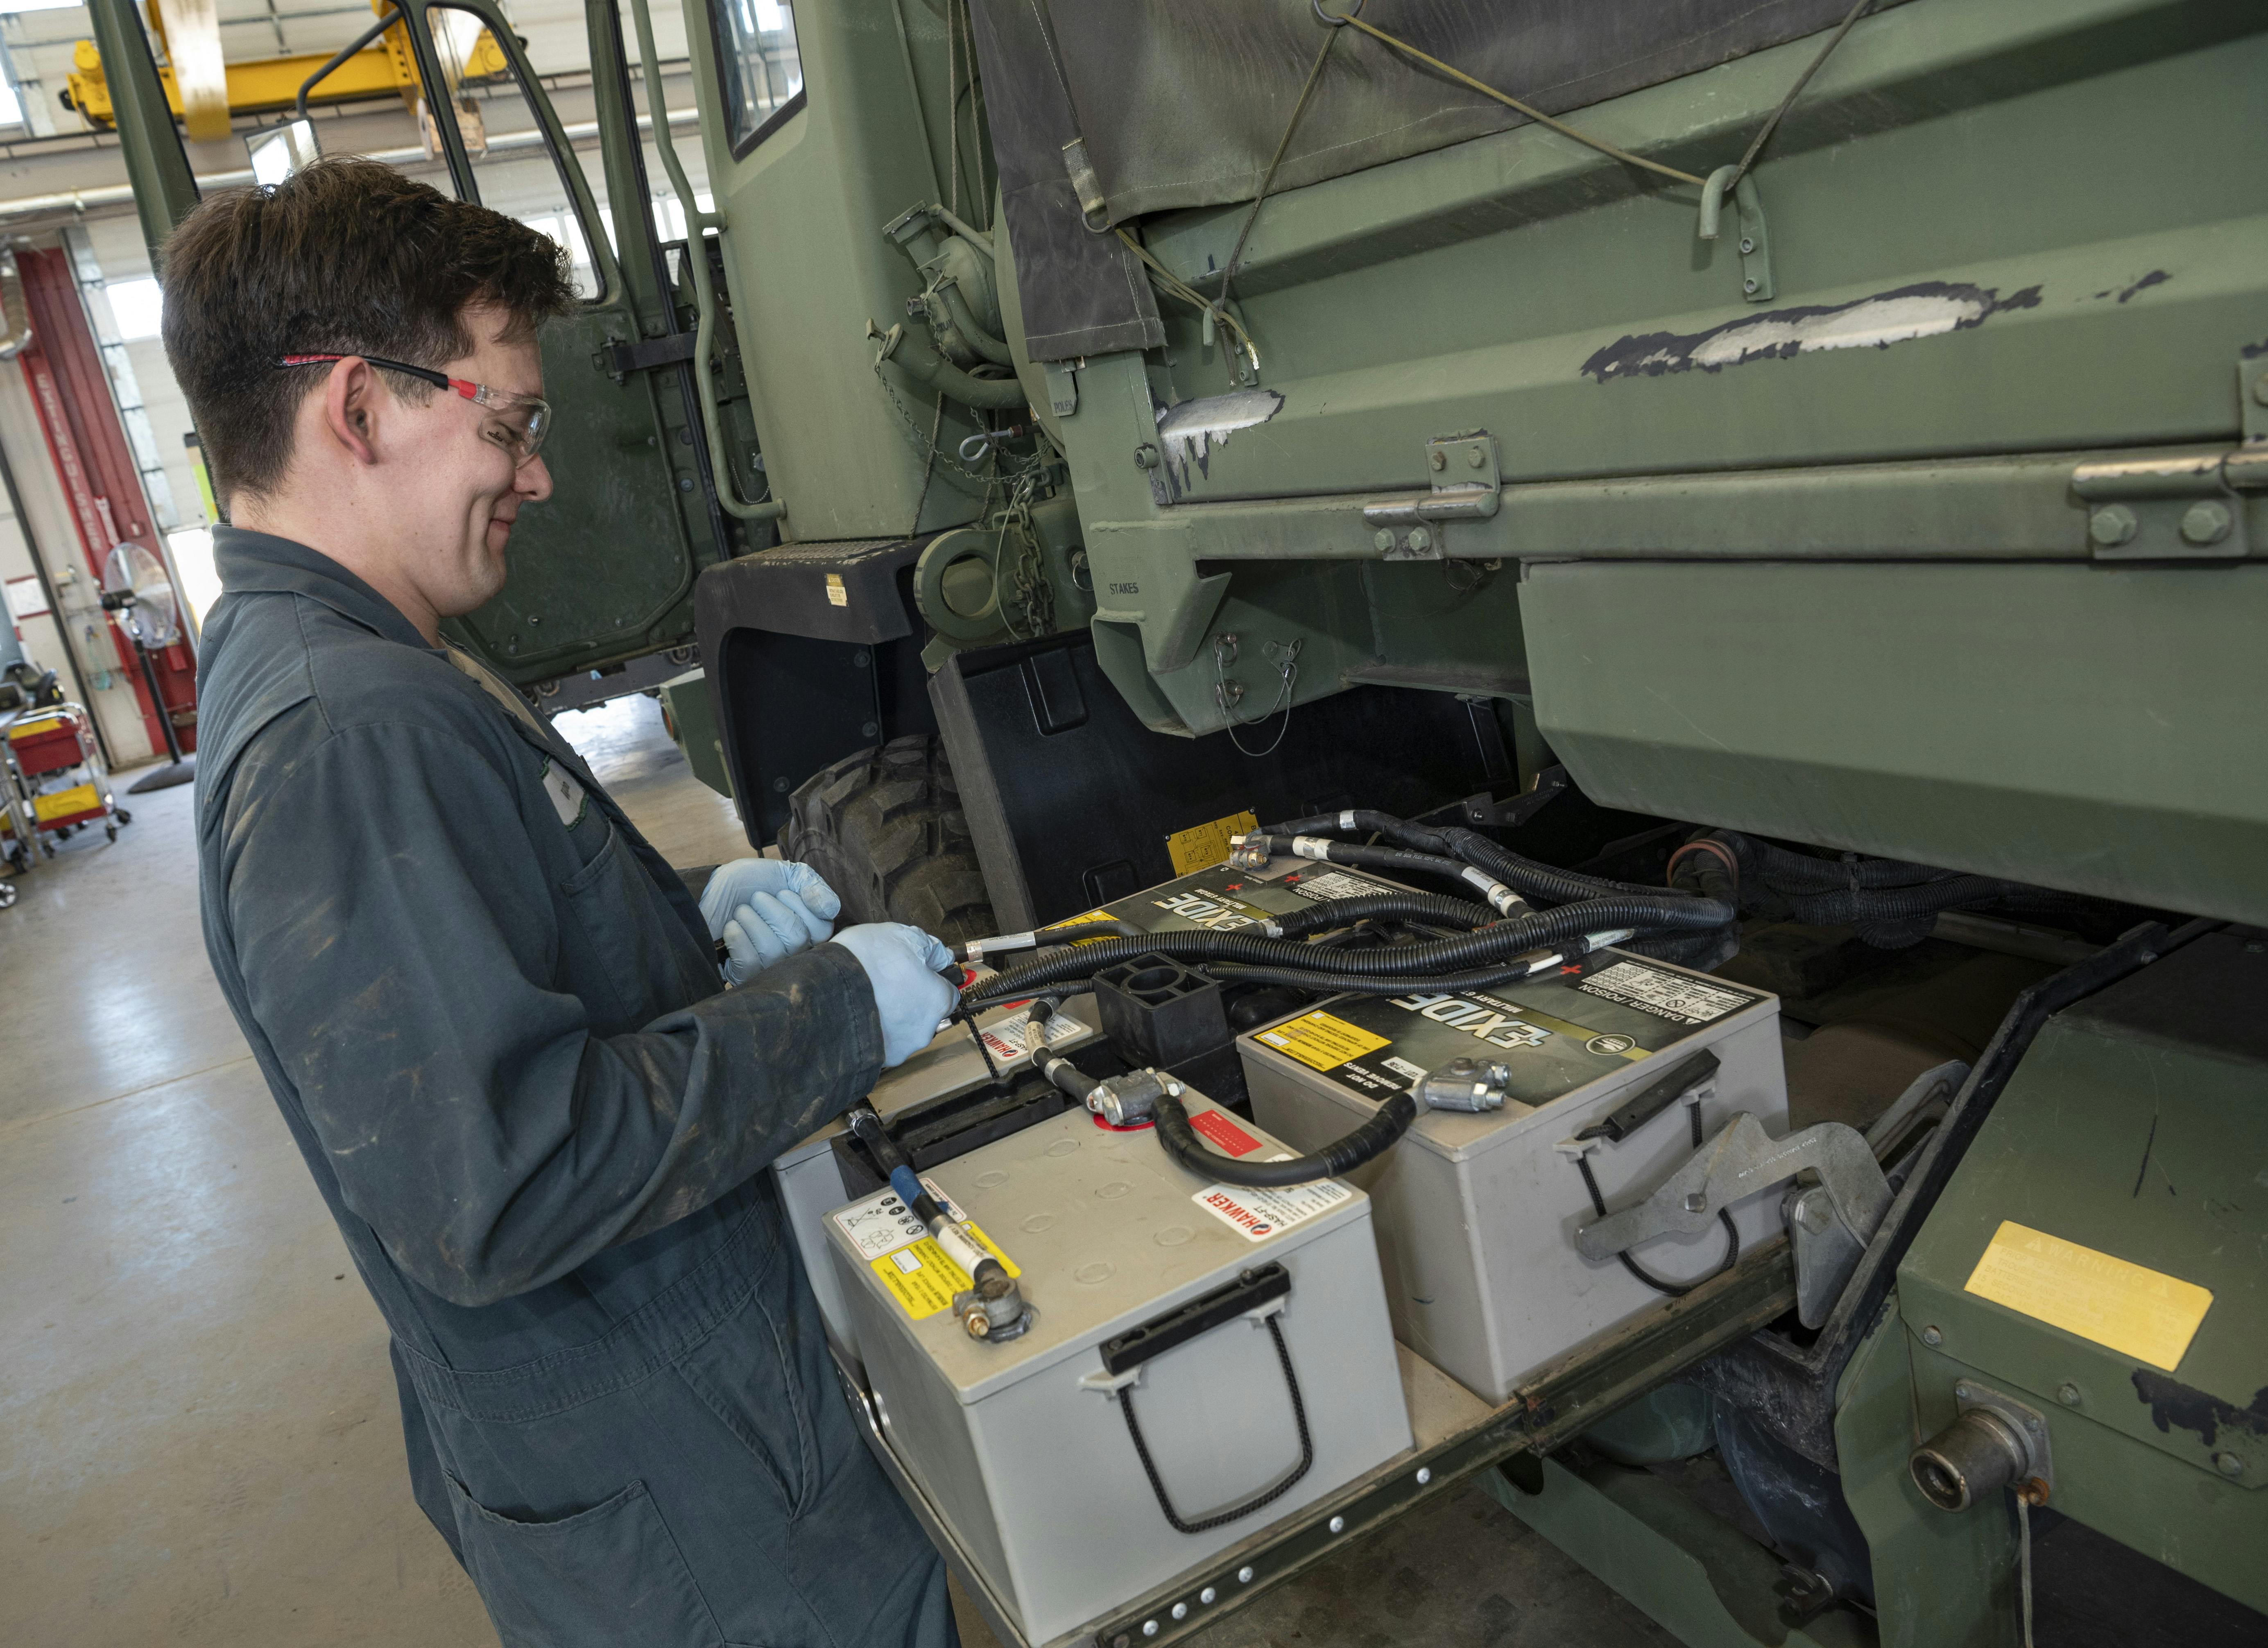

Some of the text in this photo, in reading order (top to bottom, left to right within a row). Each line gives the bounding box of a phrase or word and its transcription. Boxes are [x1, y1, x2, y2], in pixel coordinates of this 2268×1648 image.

[1053, 399, 1073, 413] POLES
[1109, 582, 1139, 595] STAKES
[1219, 896, 1247, 910] MILITARY
[1292, 887, 1320, 901] POISON
[1153, 892, 1260, 932] EXIDE
[1473, 993, 1524, 1014] MILITARY
[1578, 983, 1625, 1003] POISON
[1389, 993, 1553, 1049] EXIDE
[1629, 999, 1686, 1022] DANGER
[980, 1032, 1012, 1053] HAWKER
[1343, 1062, 1402, 1090] REMOVE VENTS
[1346, 1074, 1366, 1082] NOT
[1206, 1192, 1261, 1228] HAWKER
[1253, 1206, 1288, 1227] HASP-FT
[2046, 1242, 2147, 1288] WARNING
